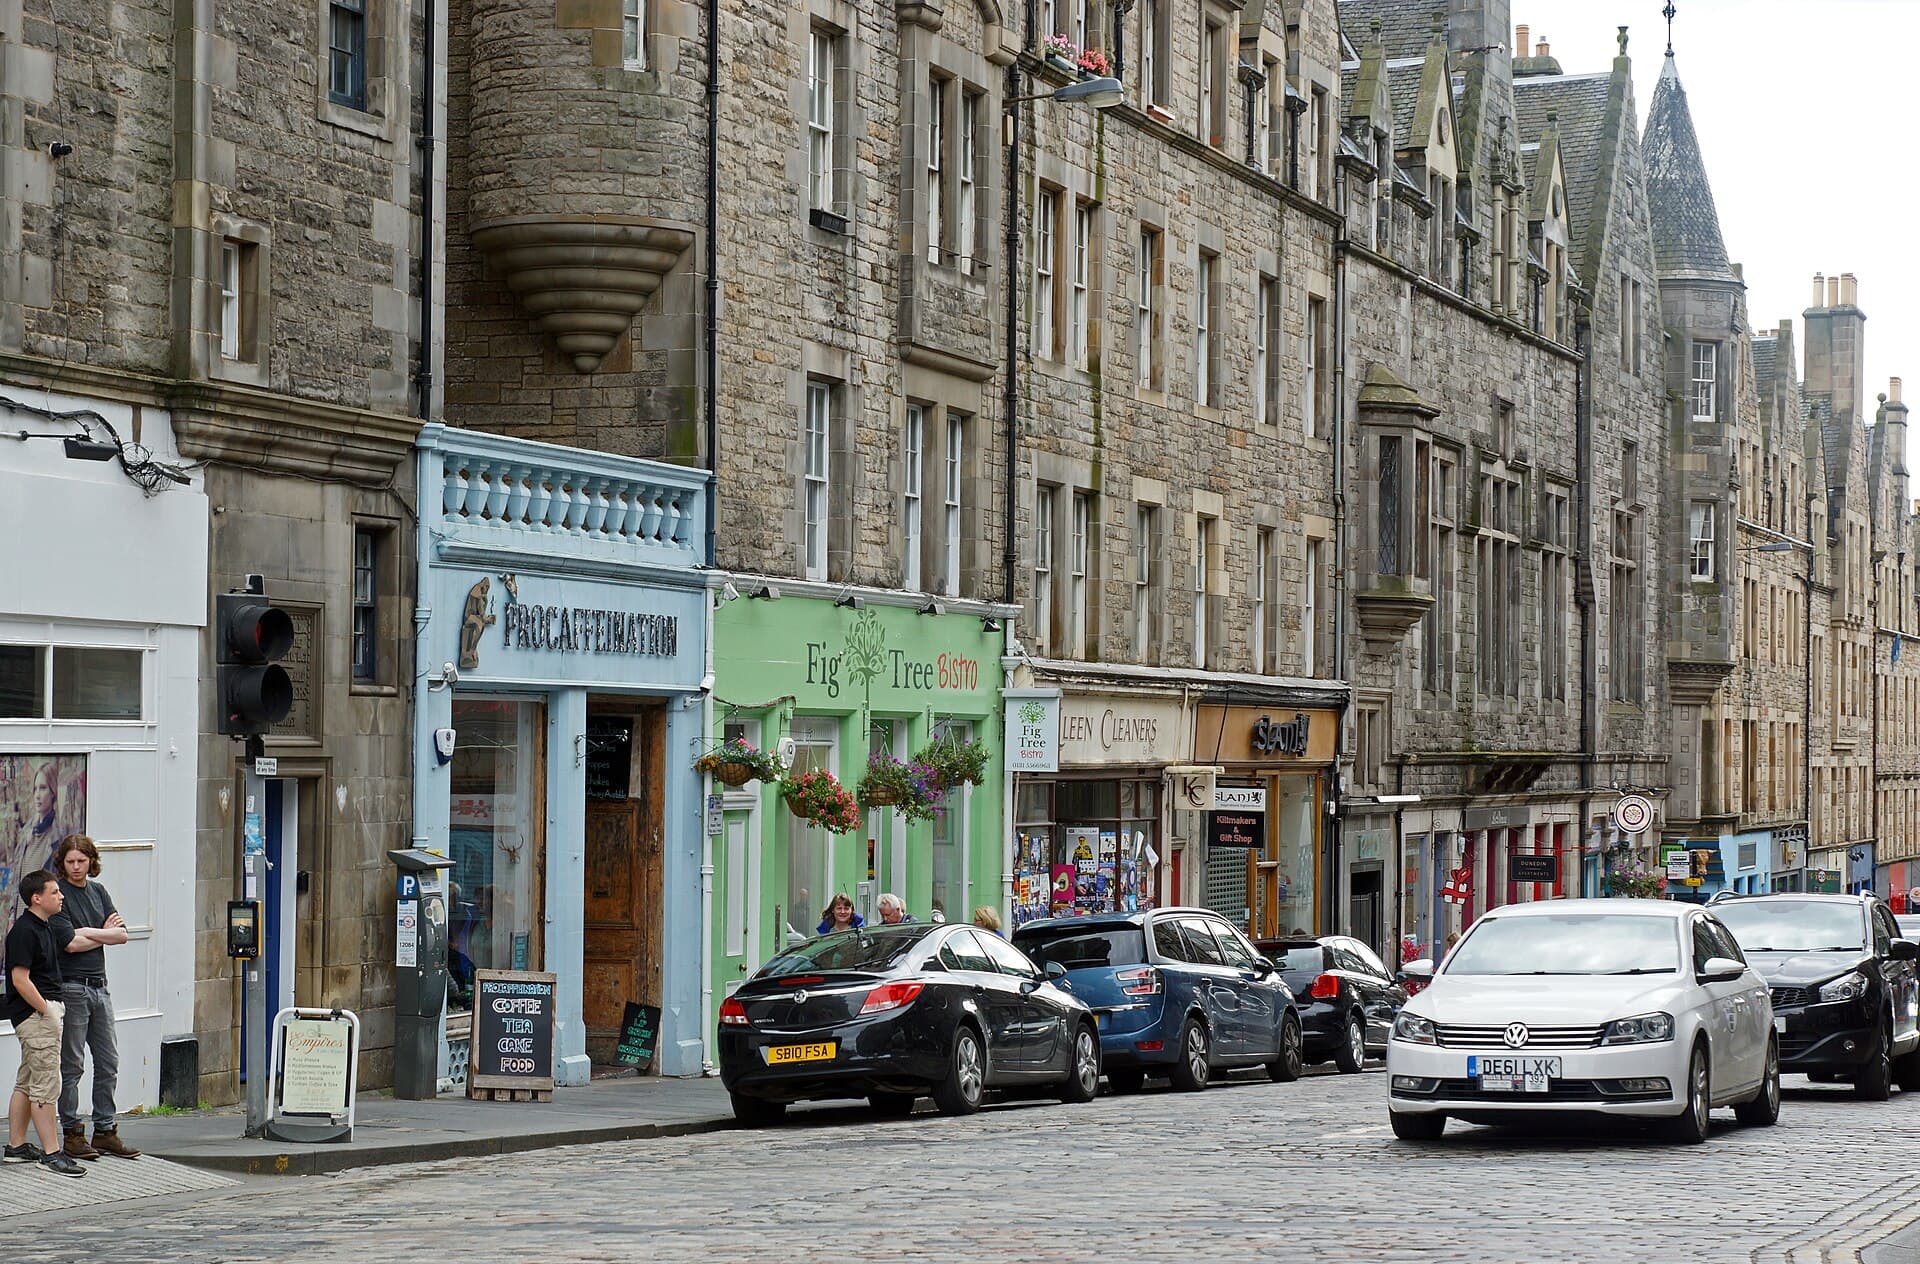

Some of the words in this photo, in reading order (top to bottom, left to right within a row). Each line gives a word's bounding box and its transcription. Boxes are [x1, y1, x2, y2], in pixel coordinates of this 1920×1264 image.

[503, 600, 678, 657] PROCAFFEINATION
[805, 641, 842, 698] Fig
[888, 650, 934, 690] Tree
[937, 652, 978, 691] Bistro
[1023, 725, 1042, 738] Fig
[1060, 715, 1094, 747] LEEN
[1101, 709, 1157, 749] CLEANERS
[1018, 737, 1046, 748] Tree
[1020, 749, 1043, 759] Bistro
[1216, 815, 1256, 825] Kiltmakers
[1219, 834, 1233, 842] Gift
[1234, 834, 1252, 844] Shop
[403, 875, 415, 896] P
[482, 982, 552, 995] PROCAFFEINATION
[492, 998, 542, 1014] COFFEE
[502, 1017, 533, 1034] TEA
[289, 1031, 344, 1054] Empires
[497, 1037, 533, 1053] CAKE
[776, 1047, 802, 1060] SB10
[805, 1045, 828, 1058] FSA
[500, 1057, 535, 1073] FOOD
[1482, 1059, 1519, 1075] DE61
[1522, 1059, 1555, 1075] LXK
[1529, 1074, 1545, 1083] 392
